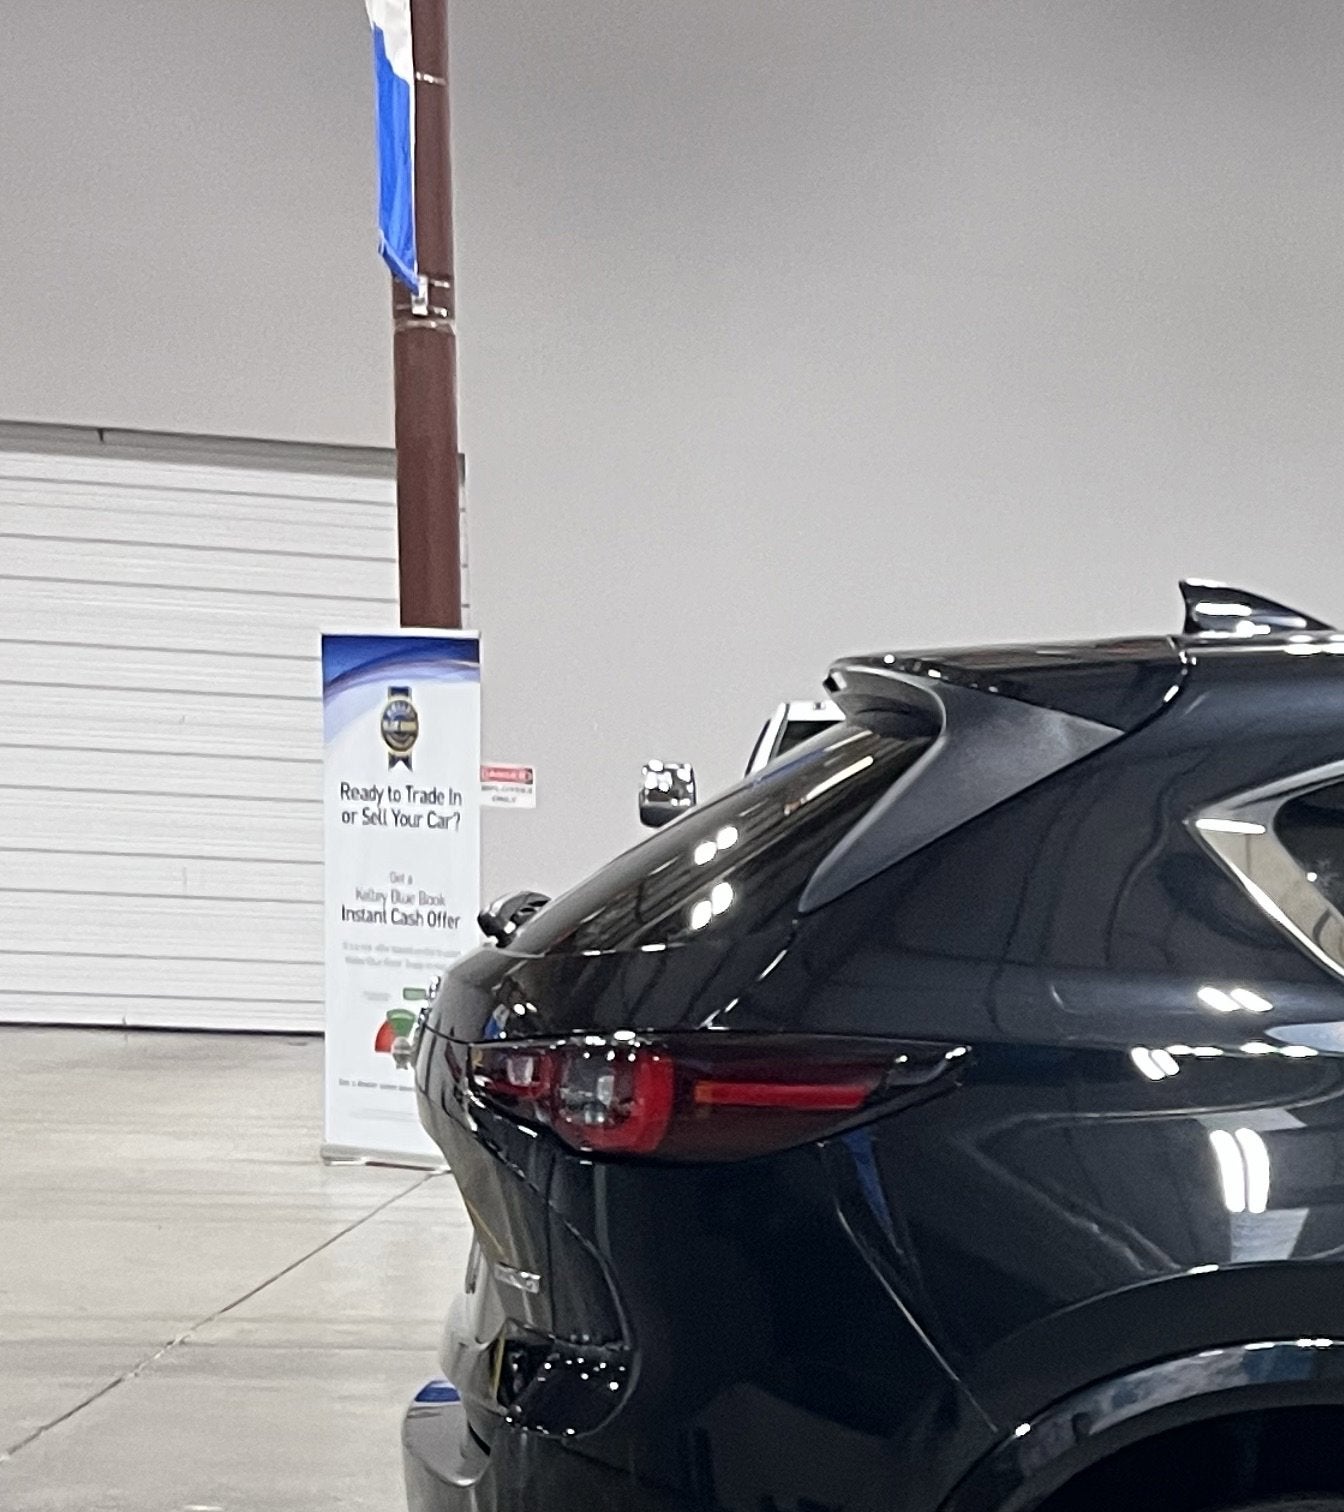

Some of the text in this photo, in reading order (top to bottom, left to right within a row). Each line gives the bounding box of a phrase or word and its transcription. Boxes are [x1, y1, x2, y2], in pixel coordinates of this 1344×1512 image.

[340, 781, 384, 808] Ready
[387, 785, 402, 803] to
[405, 784, 445, 806] Trade
[448, 787, 462, 806] In
[341, 806, 461, 832] or Sell Your Car?
[341, 903, 461, 929] Instant Cash Offer
